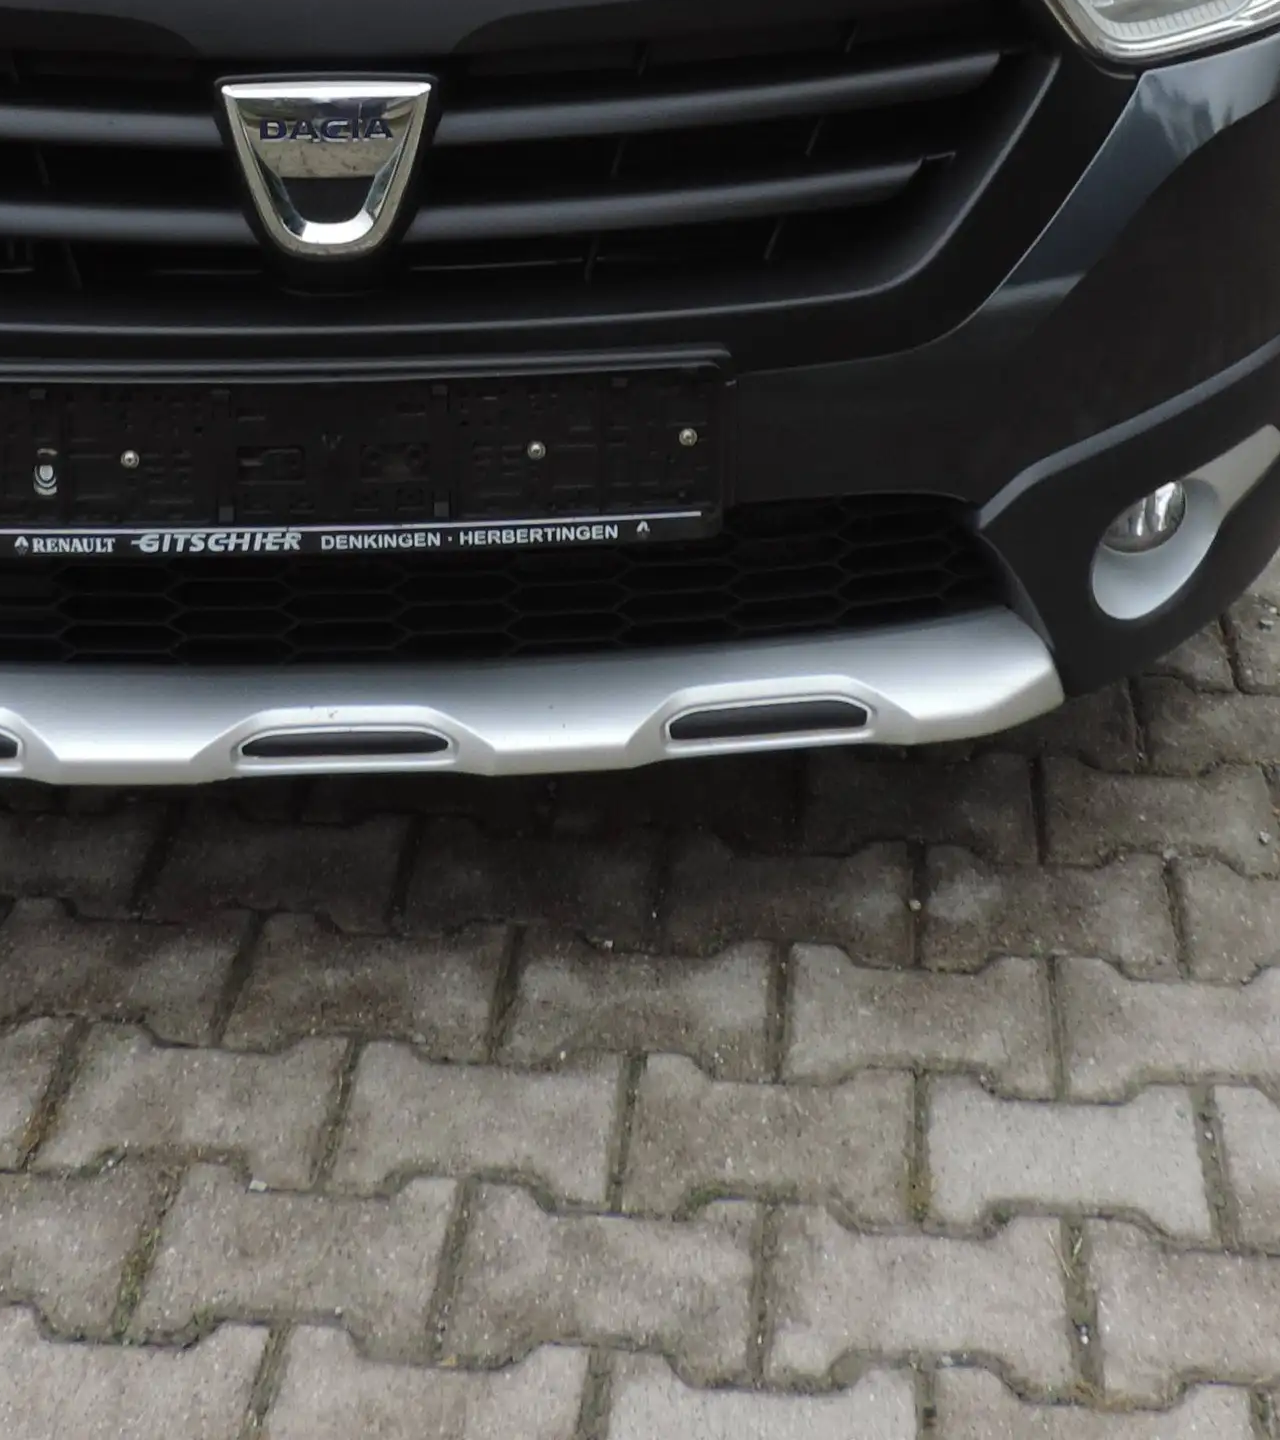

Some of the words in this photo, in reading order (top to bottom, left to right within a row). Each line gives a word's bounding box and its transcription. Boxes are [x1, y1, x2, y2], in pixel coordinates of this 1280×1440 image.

[258, 117, 394, 143] DACIA
[31, 535, 116, 554] RENAULT
[130, 531, 303, 554] GITSCHIER
[320, 531, 442, 551] DENKINGEN
[459, 523, 620, 547] HERBERTINGEN
